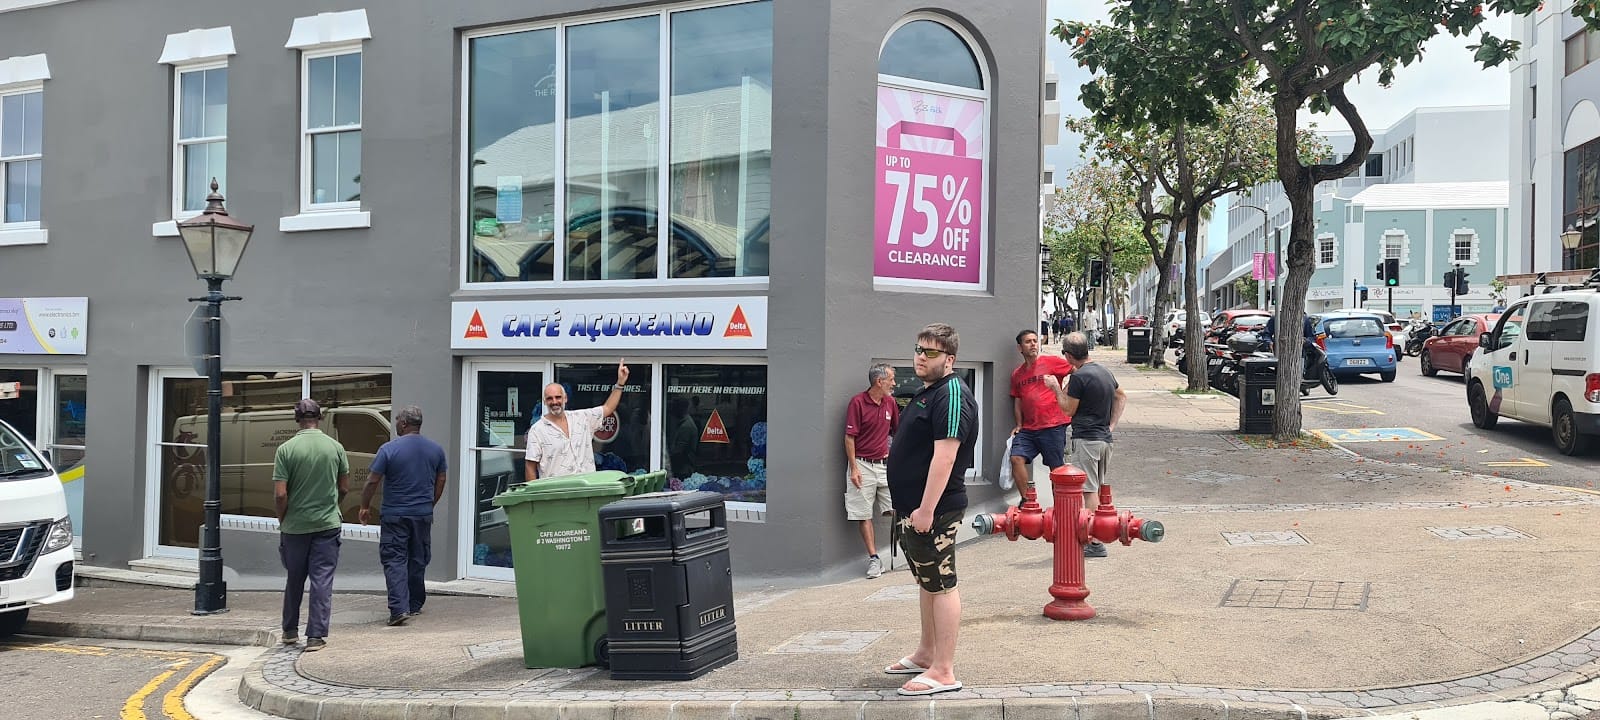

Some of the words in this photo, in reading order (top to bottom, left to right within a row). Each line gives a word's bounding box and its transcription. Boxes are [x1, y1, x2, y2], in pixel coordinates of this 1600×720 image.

[885, 154, 898, 167] UP
[899, 156, 911, 169] TO
[942, 226, 970, 251] OFF
[888, 250, 966, 268] CLEARANCE
[469, 324, 483, 332] Delta
[502, 308, 561, 337] CAFÉ
[568, 312, 715, 342] AÇOREANO
[729, 322, 747, 330] Delta
[1494, 369, 1510, 384] One
[576, 383, 601, 392] TASTE
[601, 384, 611, 392] OF
[667, 385, 692, 393] RIGHT
[692, 385, 713, 394] HERE
[713, 386, 722, 394] IN
[722, 386, 766, 395] BERMUDA!
[602, 416, 616, 425] PER
[706, 427, 723, 435] Delta
[554, 529, 588, 537] ACOREANO
[545, 536, 583, 544] WASHINGTON
[700, 608, 726, 625] LITTER
[624, 621, 663, 631] LITTER
